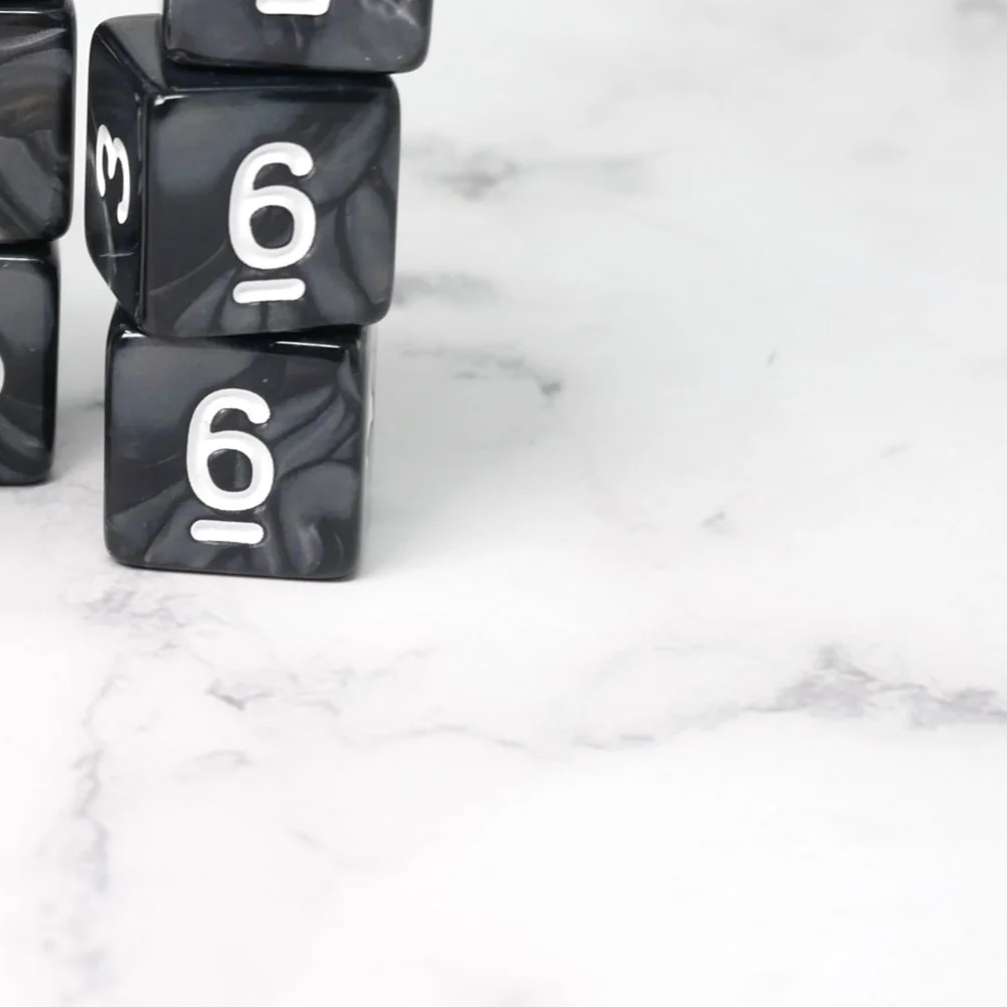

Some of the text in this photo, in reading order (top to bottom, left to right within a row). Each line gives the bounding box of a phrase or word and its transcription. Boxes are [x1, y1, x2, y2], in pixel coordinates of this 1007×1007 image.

[96, 125, 130, 224] 3
[229, 142, 316, 303] 6
[187, 388, 274, 544] 6
